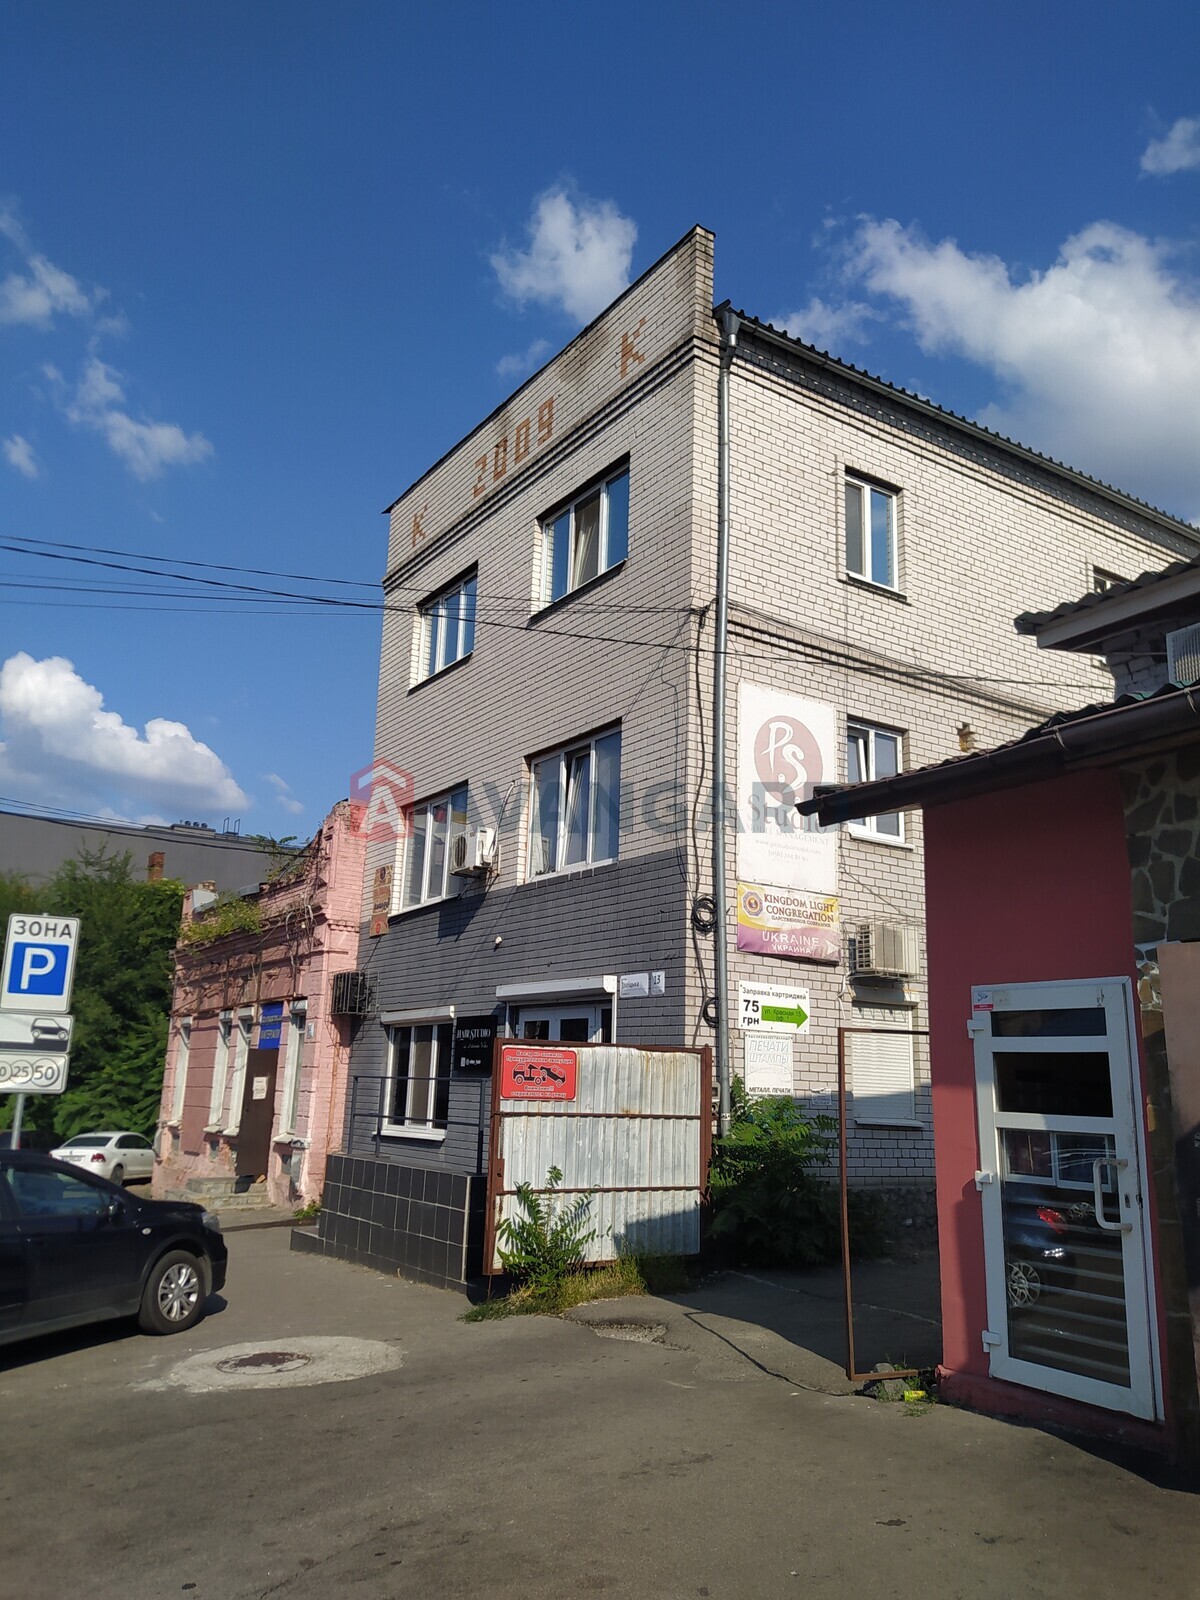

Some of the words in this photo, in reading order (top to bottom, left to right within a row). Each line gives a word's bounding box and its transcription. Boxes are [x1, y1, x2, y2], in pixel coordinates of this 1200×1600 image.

[473, 396, 556, 499] 2009
[763, 893, 807, 909] KINGDOM
[810, 900, 834, 913] LIGHT
[766, 905, 834, 922] CONGREGATION
[14, 919, 73, 939] ЗОНА
[762, 931, 820, 947] UKRAINE
[771, 944, 812, 954] УКРАИНА
[20, 946, 56, 990] P
[742, 986, 770, 996] Заправка
[771, 992, 807, 1000] картриджей
[743, 999, 760, 1013] 75
[742, 1016, 760, 1026] грн
[749, 1040, 789, 1053] ПЕЧАТИ
[749, 1053, 789, 1064] ШТАМПЫ
[11, 1065, 29, 1078] 25
[33, 1065, 55, 1080] 50
